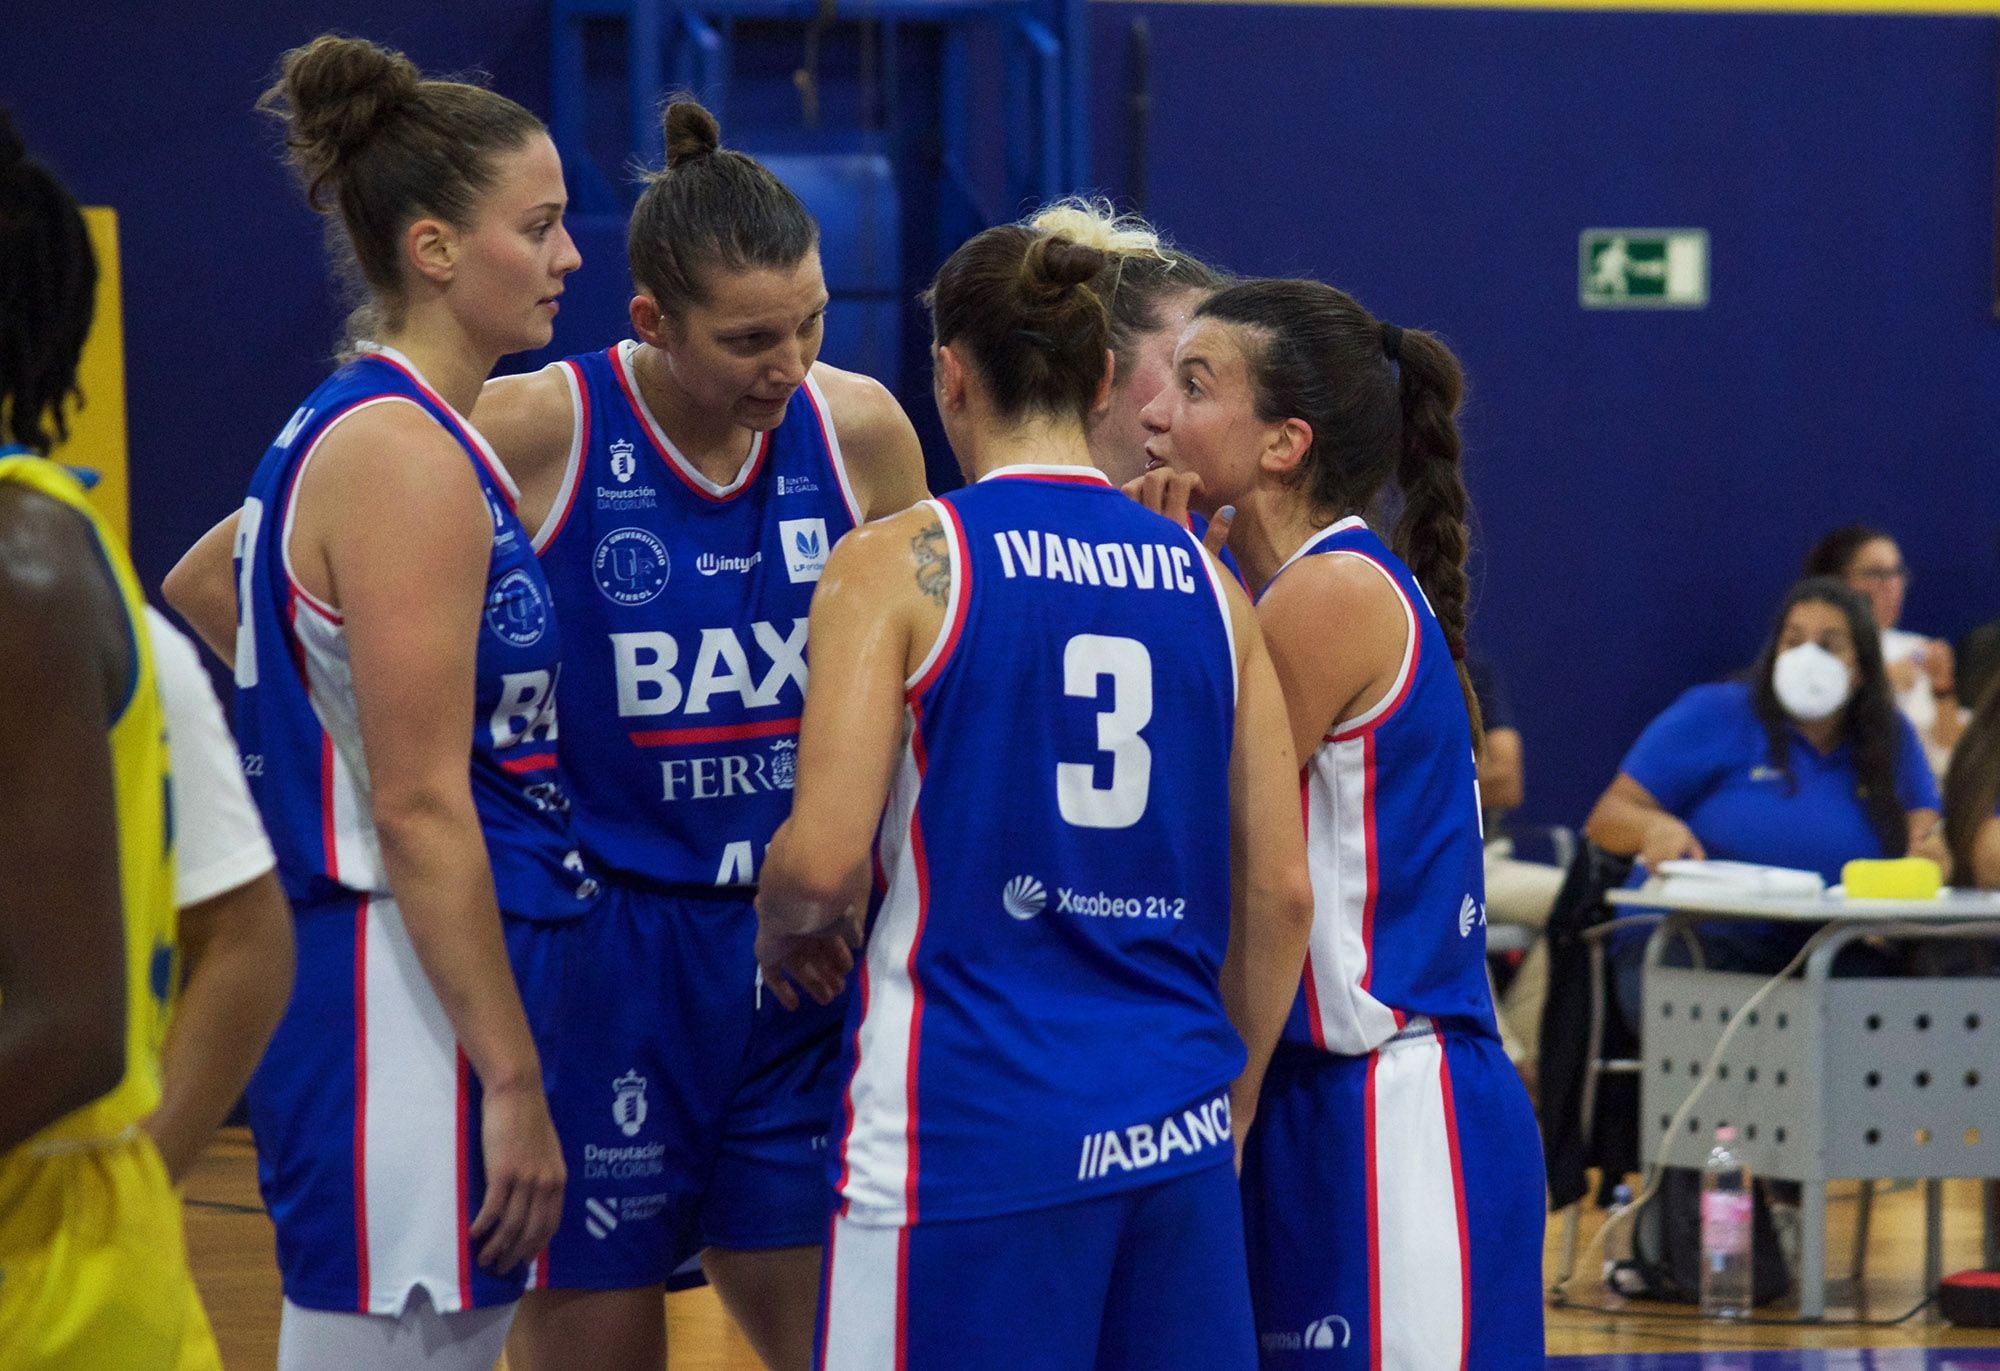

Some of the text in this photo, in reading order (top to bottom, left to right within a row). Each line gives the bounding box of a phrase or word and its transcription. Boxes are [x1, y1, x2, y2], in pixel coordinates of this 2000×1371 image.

[596, 485, 657, 501] Deputación
[993, 529, 1196, 594] IVANOVIC
[614, 589, 653, 601] FERROL
[1056, 633, 1153, 829] 3
